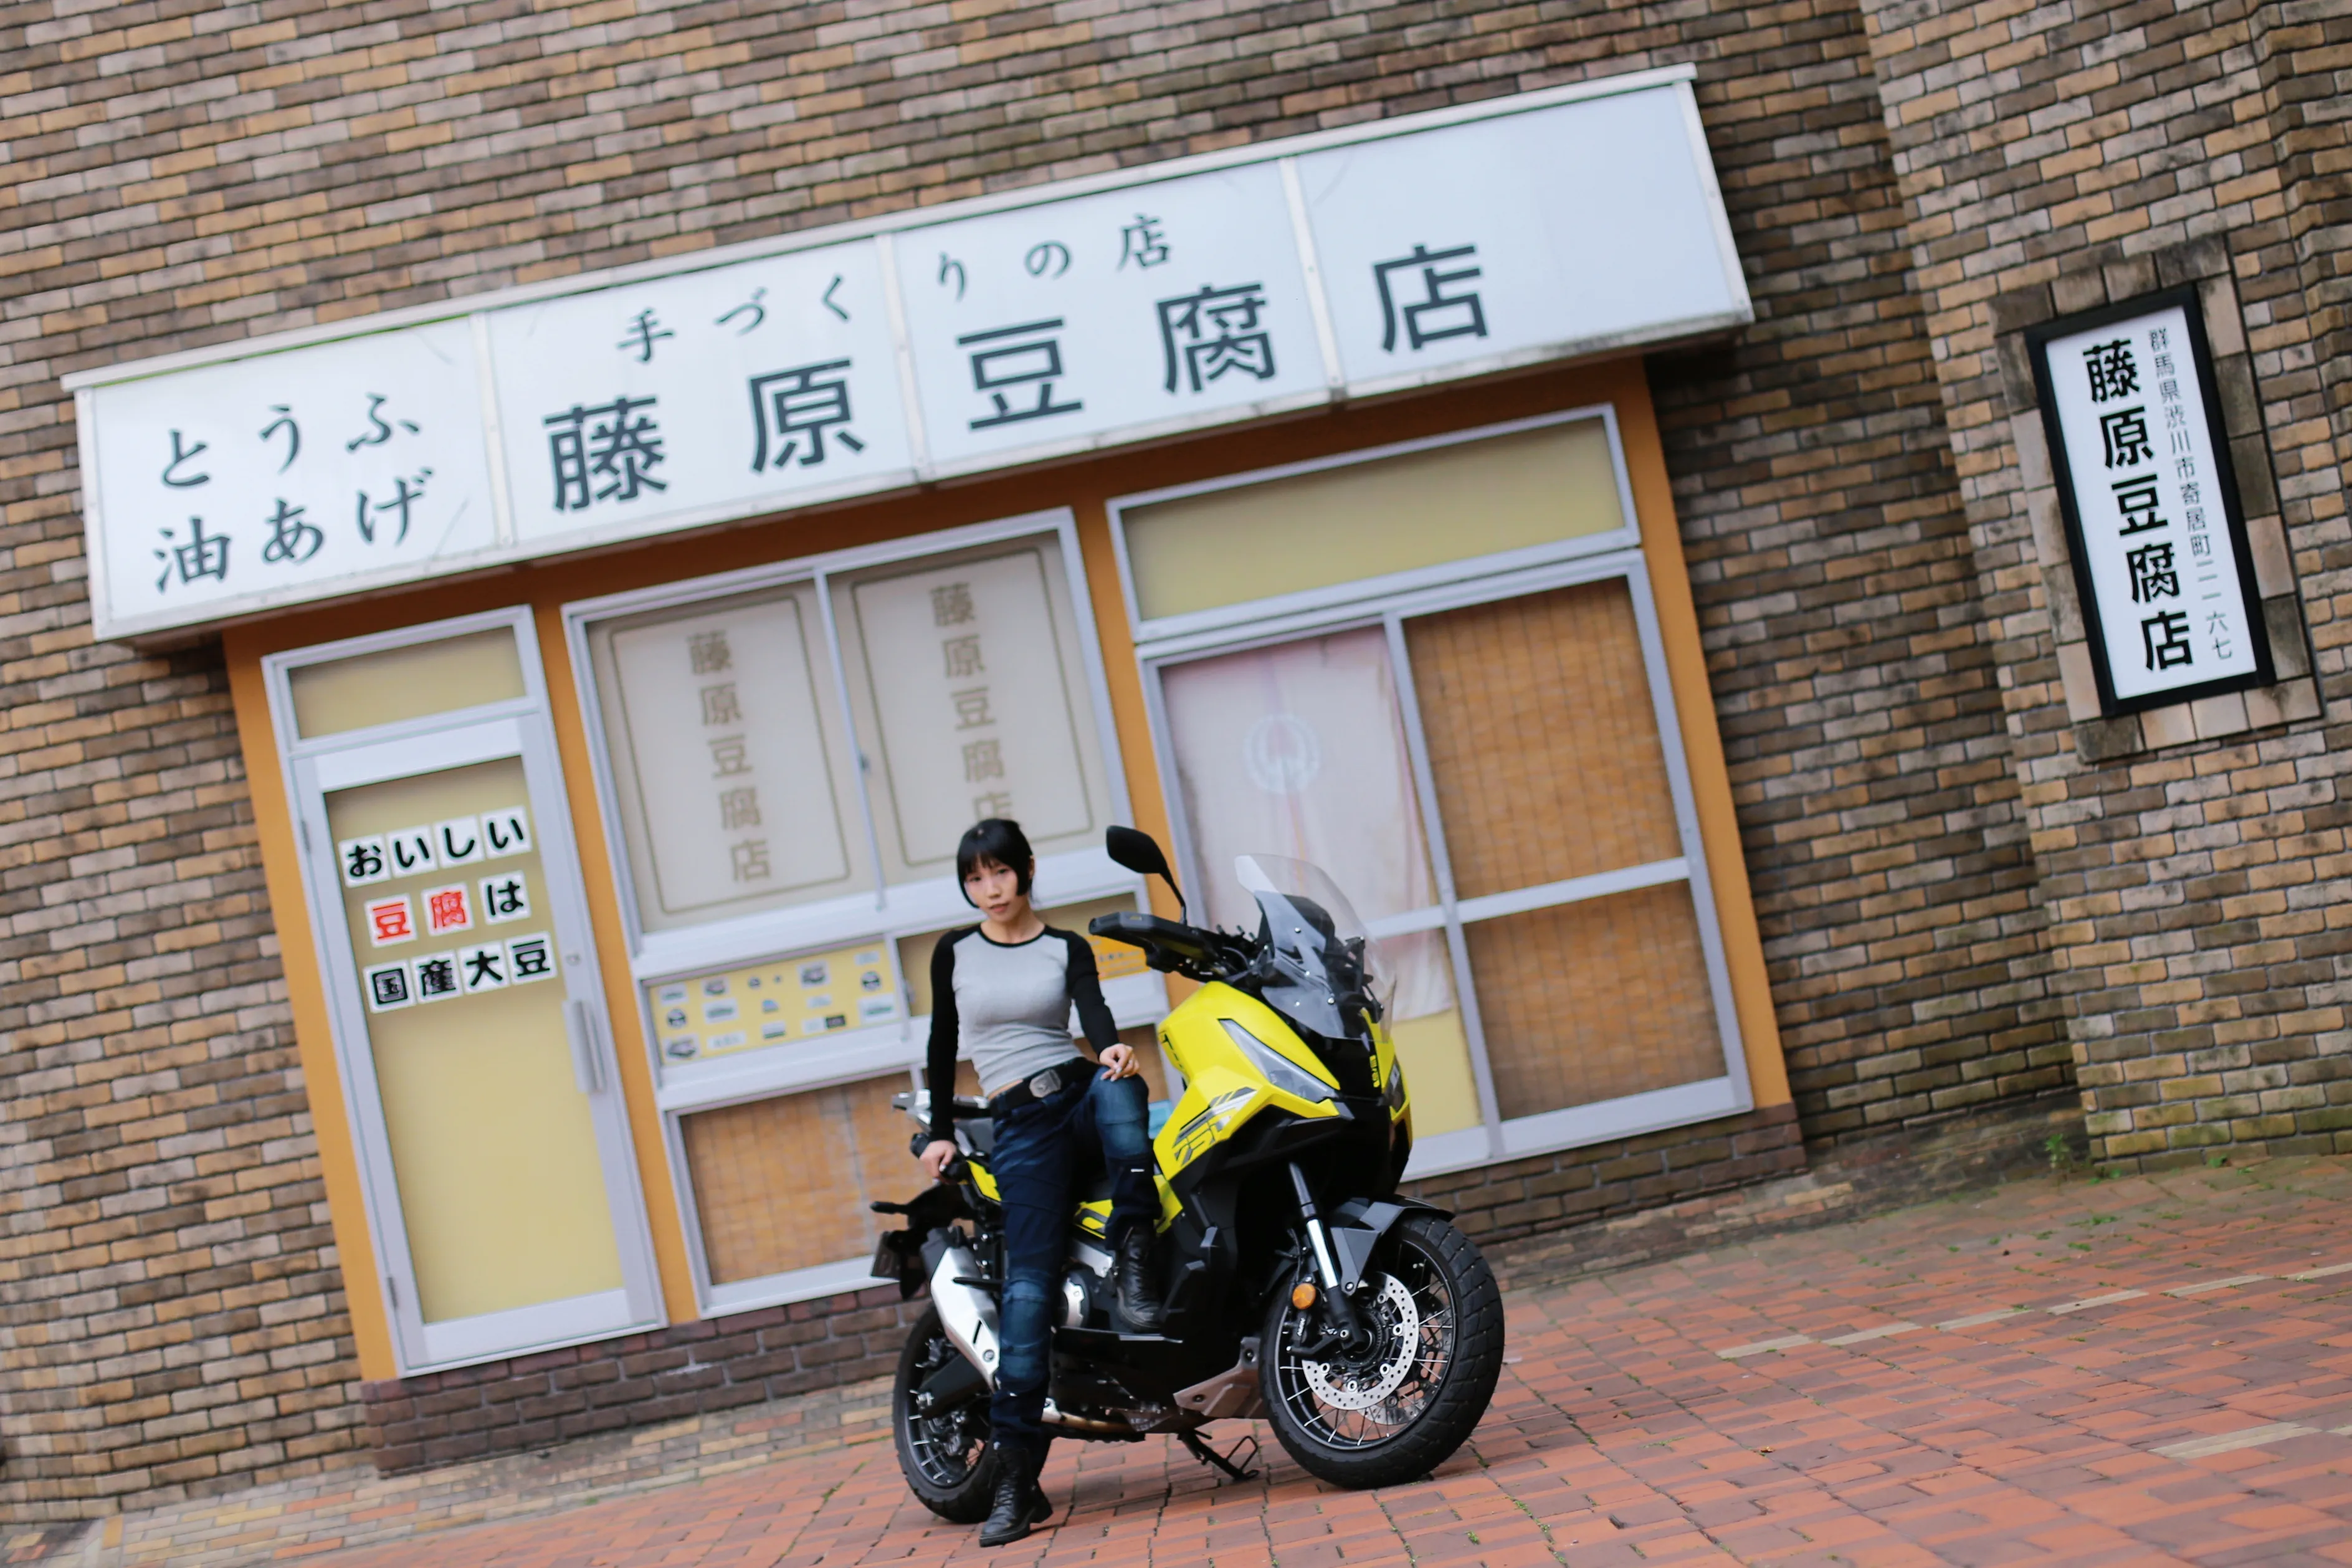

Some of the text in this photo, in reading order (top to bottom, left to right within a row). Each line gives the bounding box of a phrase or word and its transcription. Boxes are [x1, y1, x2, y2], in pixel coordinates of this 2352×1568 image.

[619, 215, 1171, 363] 手づくりの店
[161, 395, 421, 489] とうふ
[543, 244, 1489, 512] 藤原豆腐店
[155, 468, 434, 593] 油あげ
[2082, 338, 2194, 672] 藤原豆腐店
[686, 629, 772, 883] 藤原豆腐店
[928, 581, 1013, 821] 藤原豆腐店
[347, 817, 525, 878] おいしい
[372, 880, 525, 940] 豆腐は
[371, 939, 551, 1006] 国産大豆
